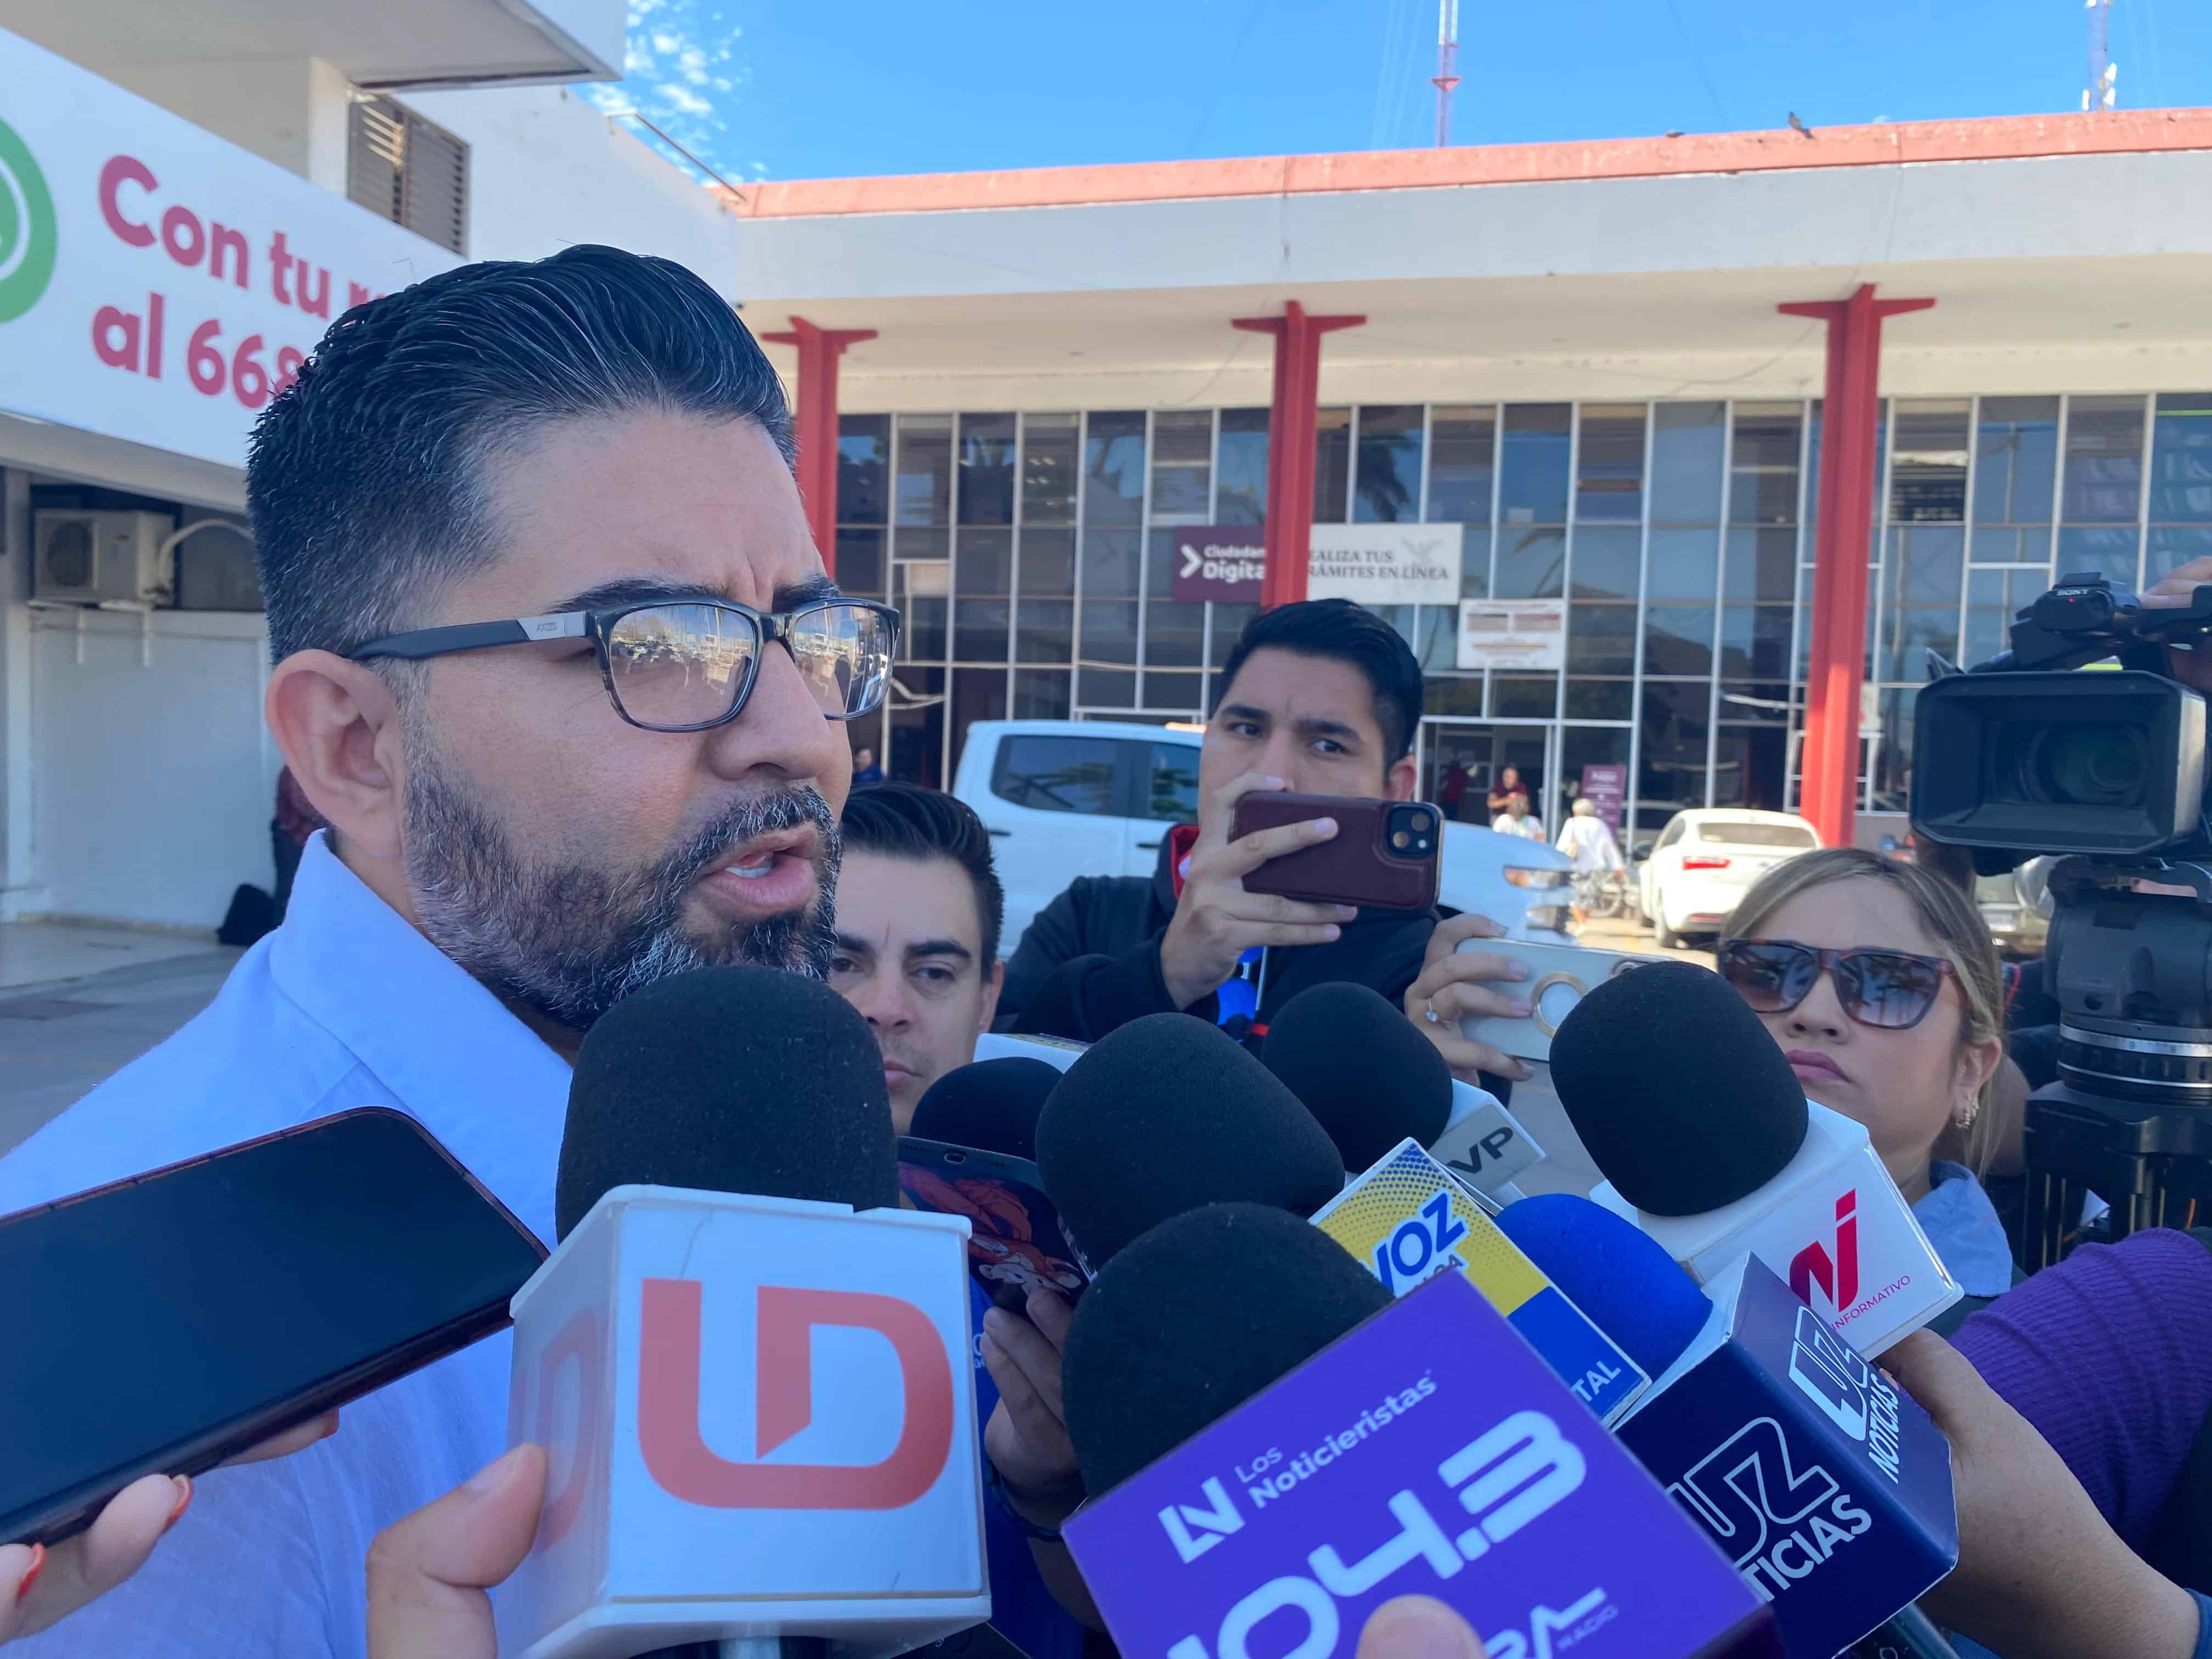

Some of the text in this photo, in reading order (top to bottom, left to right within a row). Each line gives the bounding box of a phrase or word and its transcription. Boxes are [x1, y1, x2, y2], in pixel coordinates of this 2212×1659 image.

[97, 154, 331, 319] Con tu
[92, 292, 165, 380] al
[1363, 549, 1393, 563] TUS
[1378, 566, 1398, 579] EN
[1448, 1126, 1514, 1173] VP
[1831, 1275, 1911, 1331] INFORMATIVO
[1571, 1361, 1621, 1402] TAL
[1248, 1375, 1437, 1508] Noticieristas
[1869, 1373, 1900, 1484] NOTICIAS
